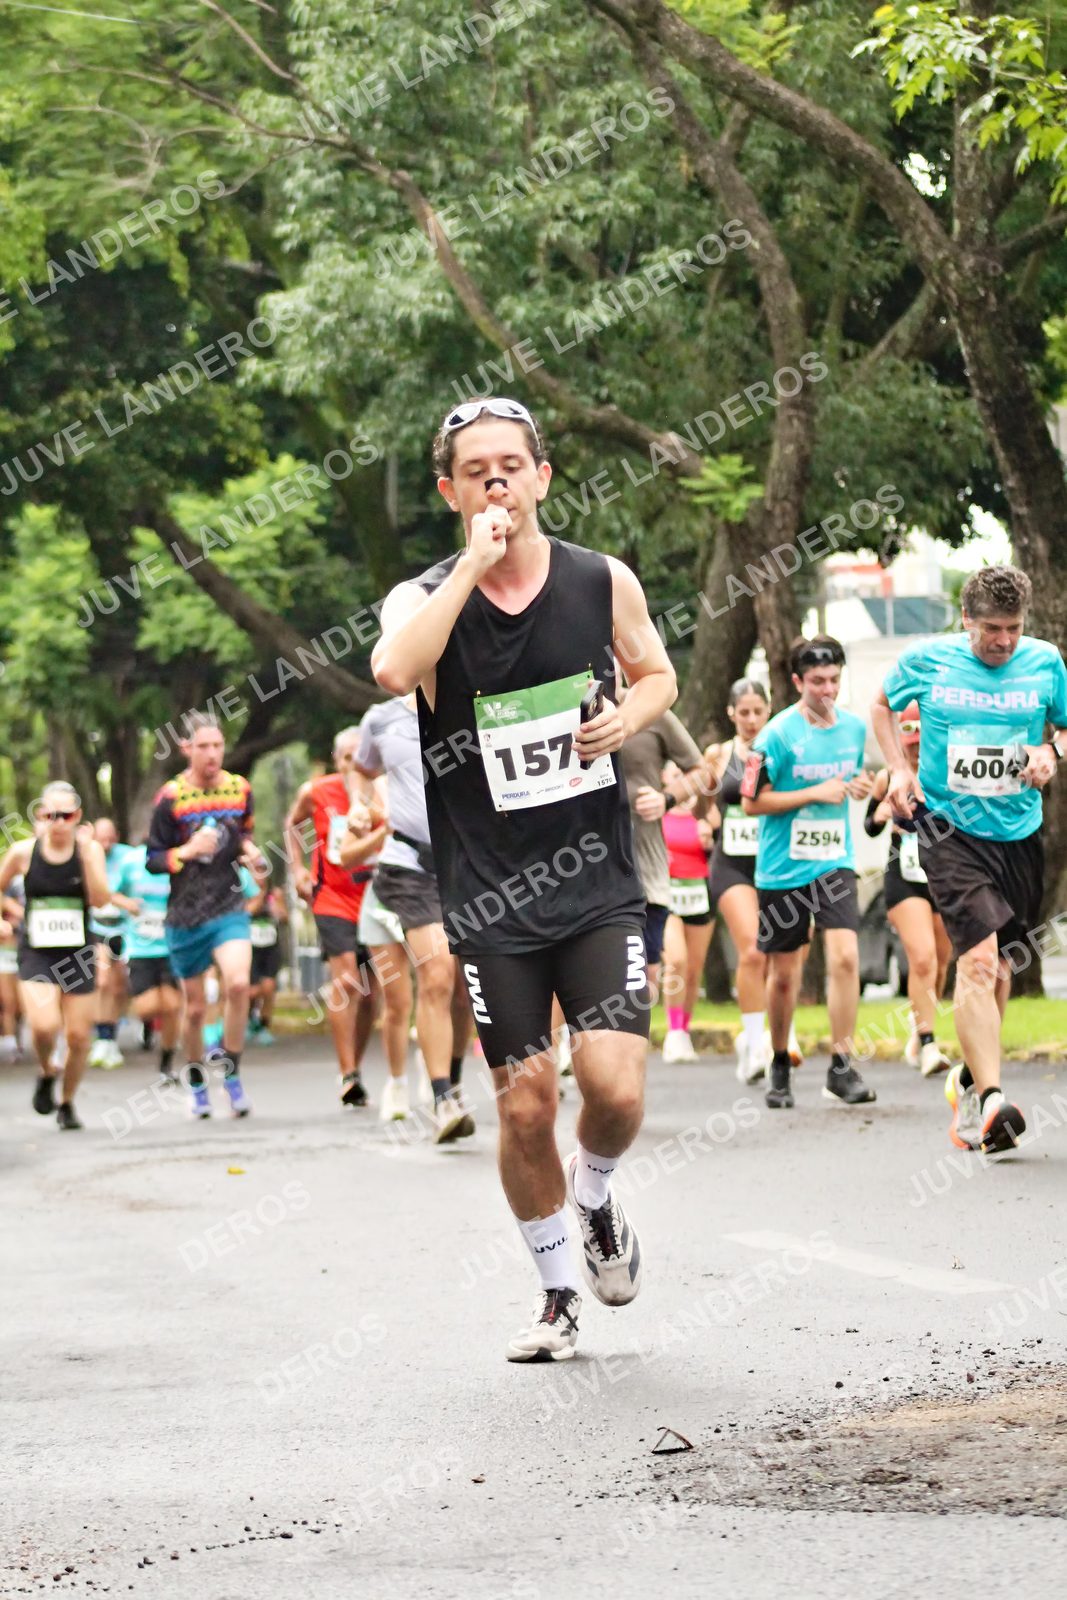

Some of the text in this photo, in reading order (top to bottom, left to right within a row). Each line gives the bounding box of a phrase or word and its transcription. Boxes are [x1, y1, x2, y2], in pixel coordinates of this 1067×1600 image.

[931, 685, 1040, 709] PERDURA
[494, 732, 574, 782] 157
[792, 761, 858, 780] PERDUR
[502, 790, 530, 800] PERDURA
[797, 830, 841, 847] 2594
